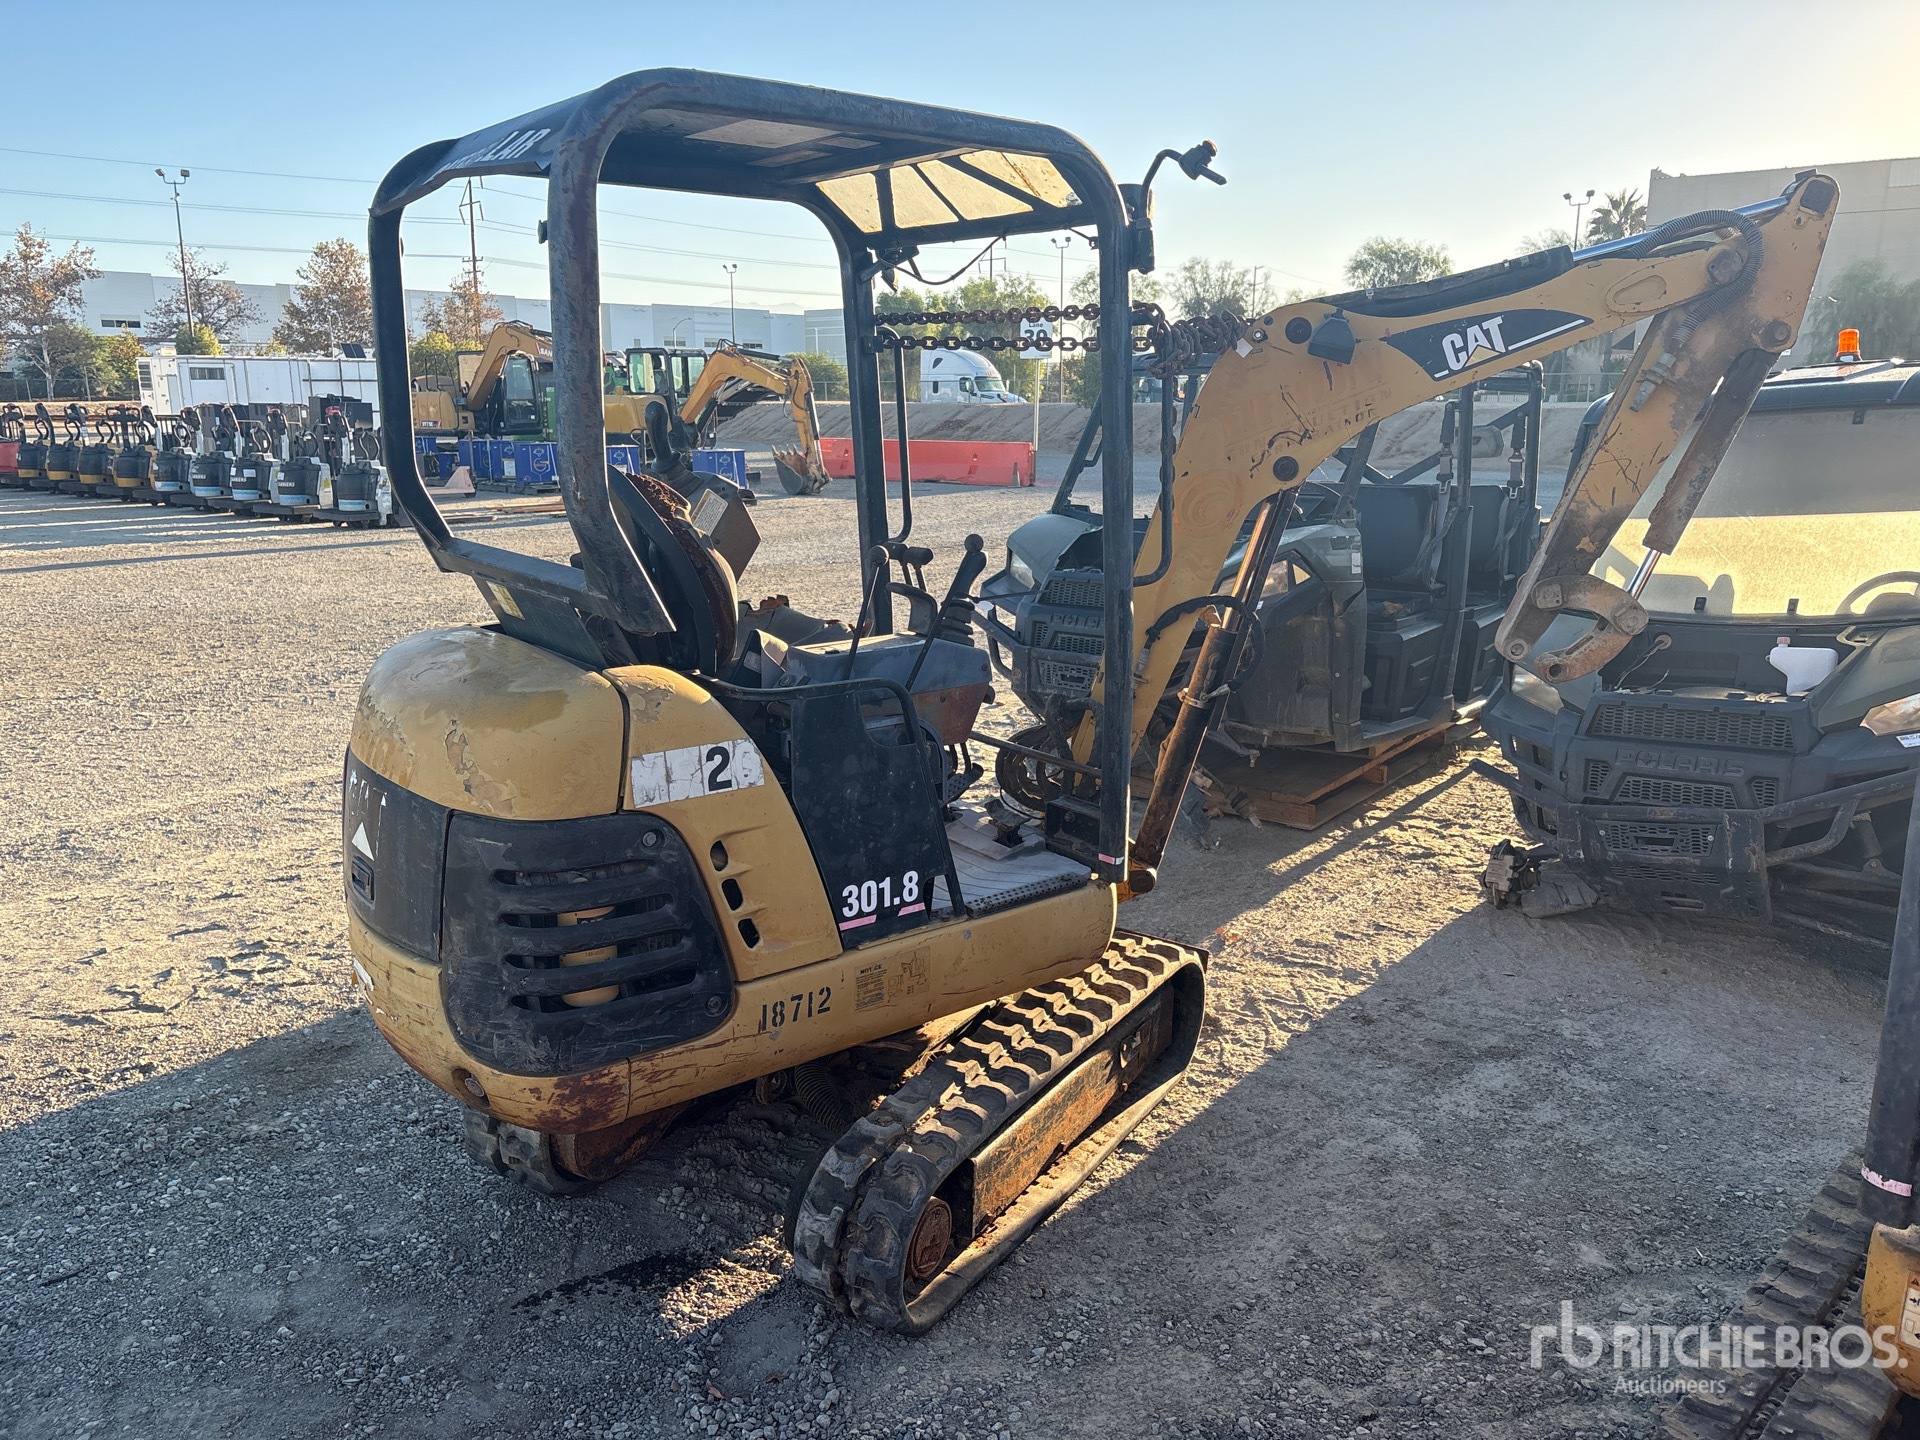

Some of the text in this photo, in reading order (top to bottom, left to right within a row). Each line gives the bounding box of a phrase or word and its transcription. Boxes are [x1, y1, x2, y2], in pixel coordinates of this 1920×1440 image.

[1442, 315, 1506, 371] CAT
[706, 746, 732, 791] 2
[1615, 748, 1745, 777] POLARIS
[842, 870, 919, 917] 301.8
[761, 986, 832, 1032] 18712
